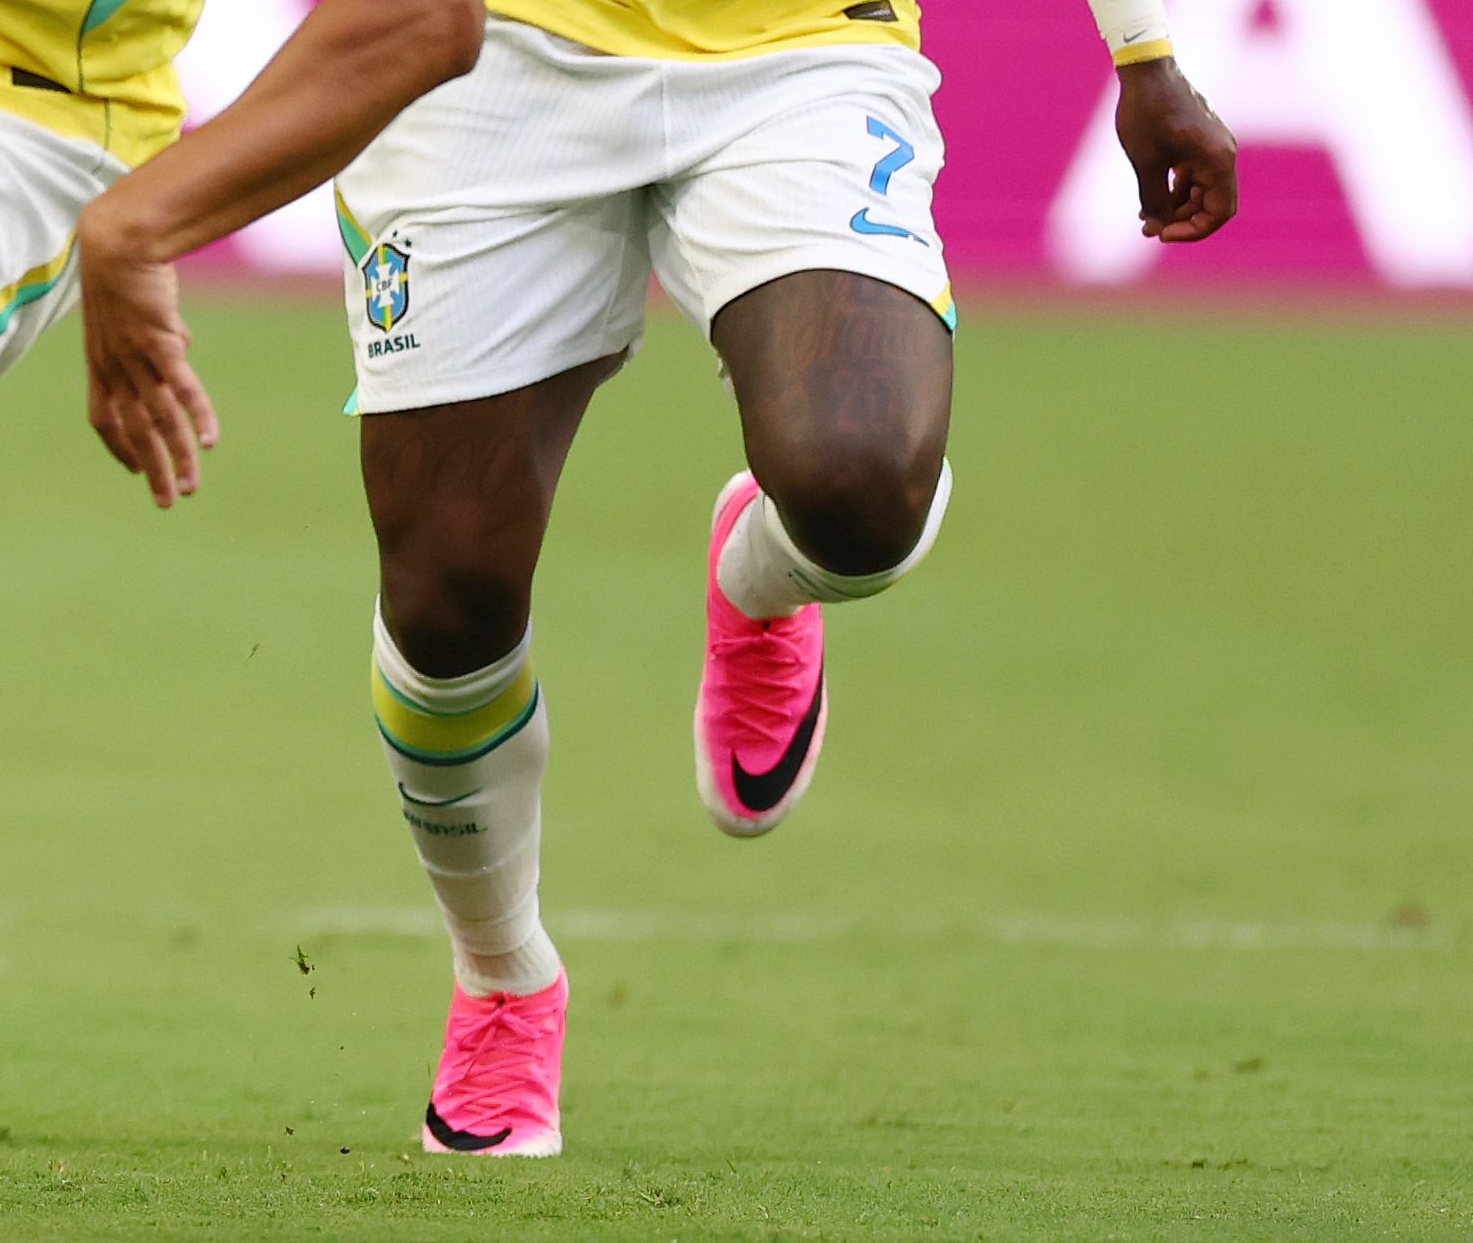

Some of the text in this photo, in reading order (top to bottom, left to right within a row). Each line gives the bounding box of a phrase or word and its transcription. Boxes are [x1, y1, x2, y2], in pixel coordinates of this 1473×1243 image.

[866, 115, 915, 196] 7
[376, 278, 393, 293] CBF
[368, 333, 421, 359] BRASIL
